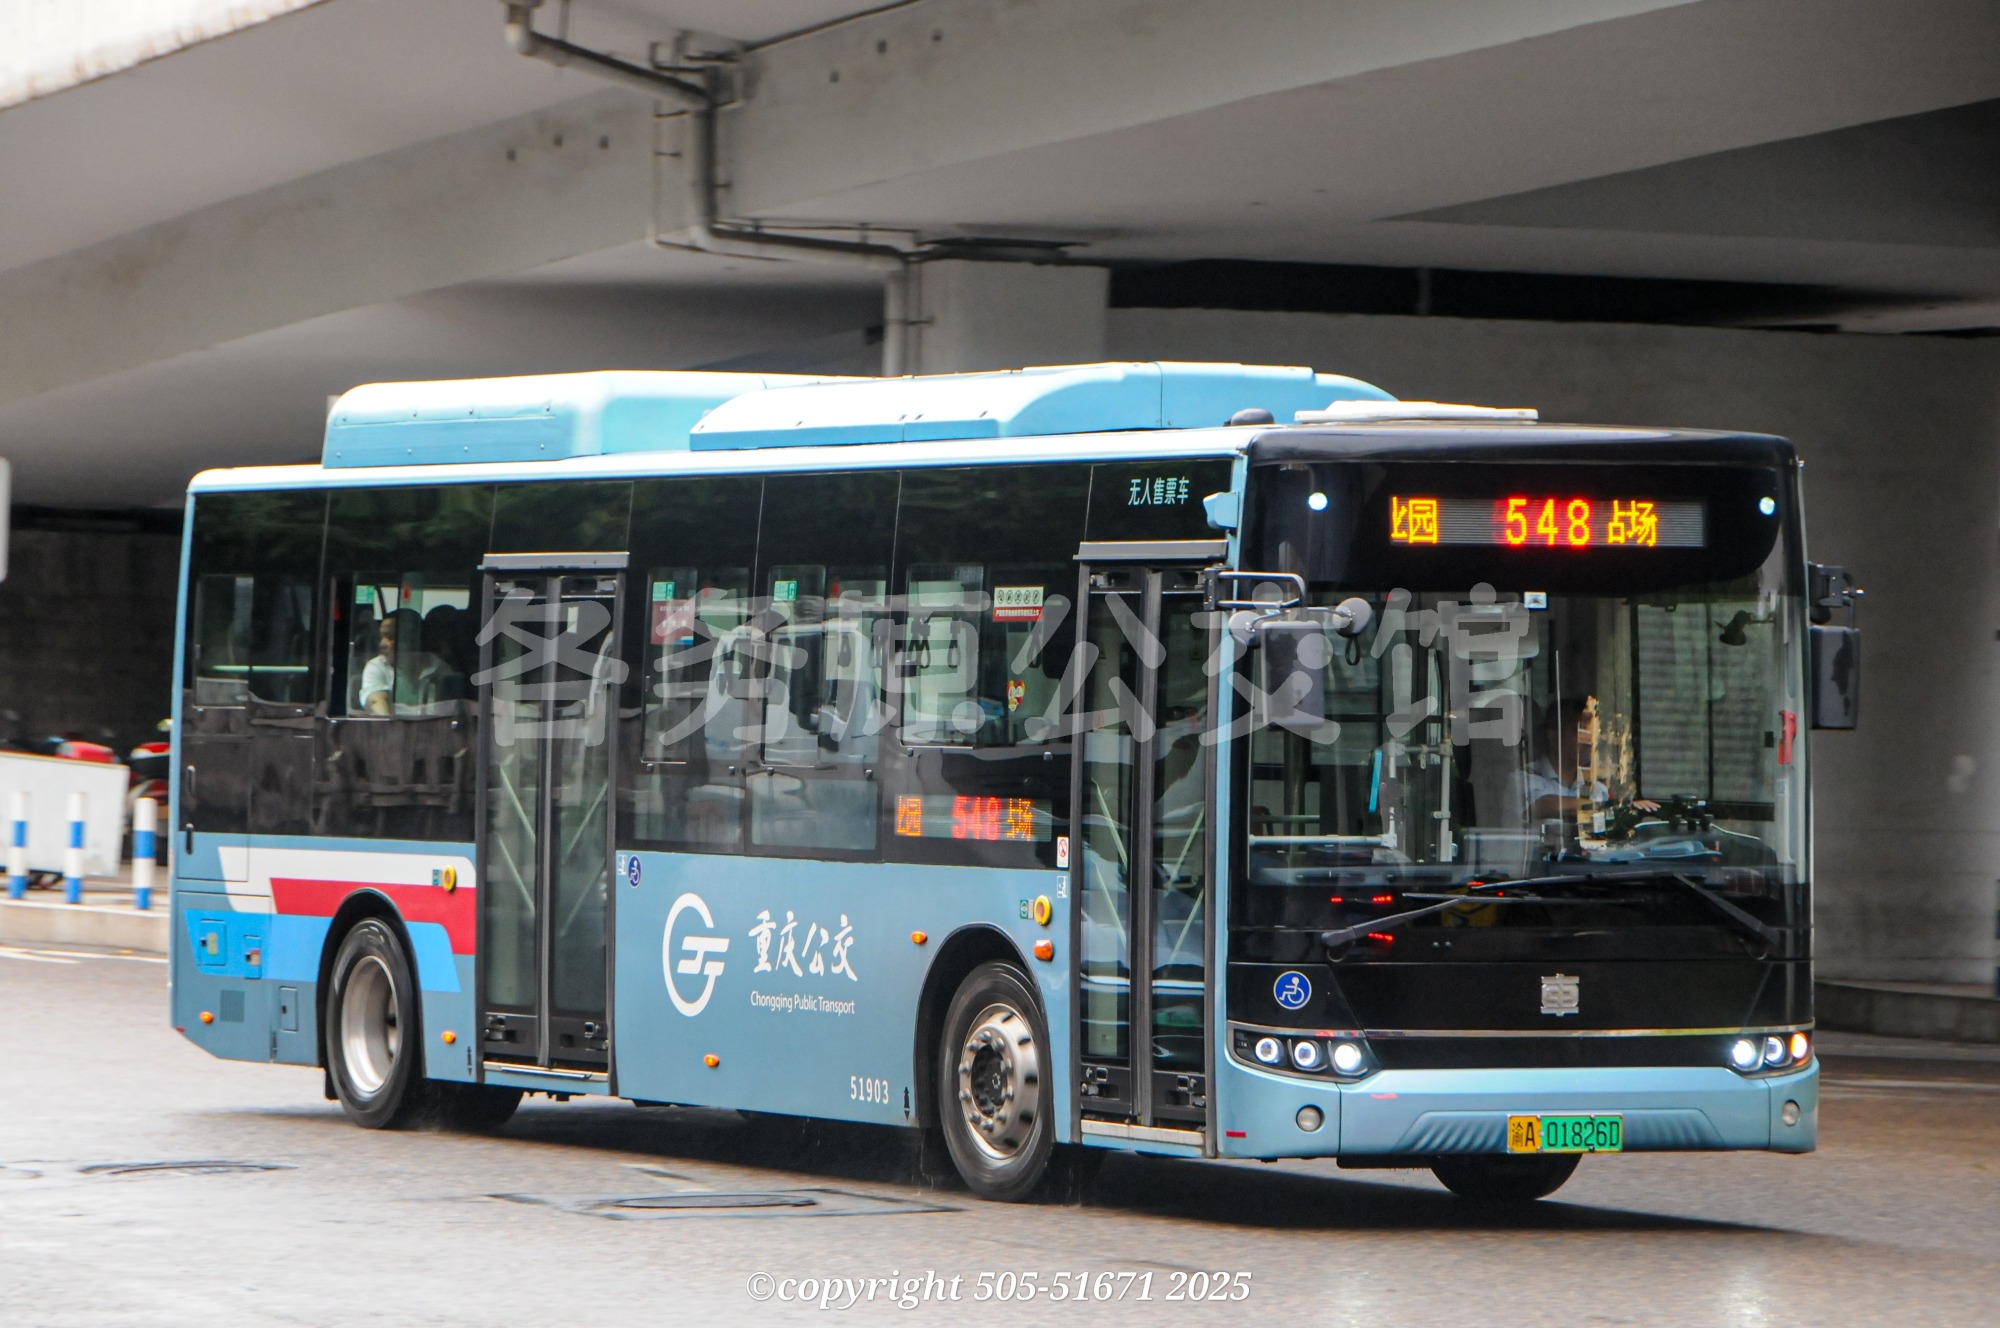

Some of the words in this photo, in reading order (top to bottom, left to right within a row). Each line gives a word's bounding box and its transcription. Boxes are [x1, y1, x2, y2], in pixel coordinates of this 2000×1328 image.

[1128, 477, 1190, 506] 无人售票车
[1504, 498, 1591, 545] 548
[748, 909, 858, 982] 重庆公交
[750, 990, 793, 1013] Chongqing
[794, 994, 818, 1011] Public
[818, 996, 855, 1016] Transport
[850, 1076, 889, 1104] 51903
